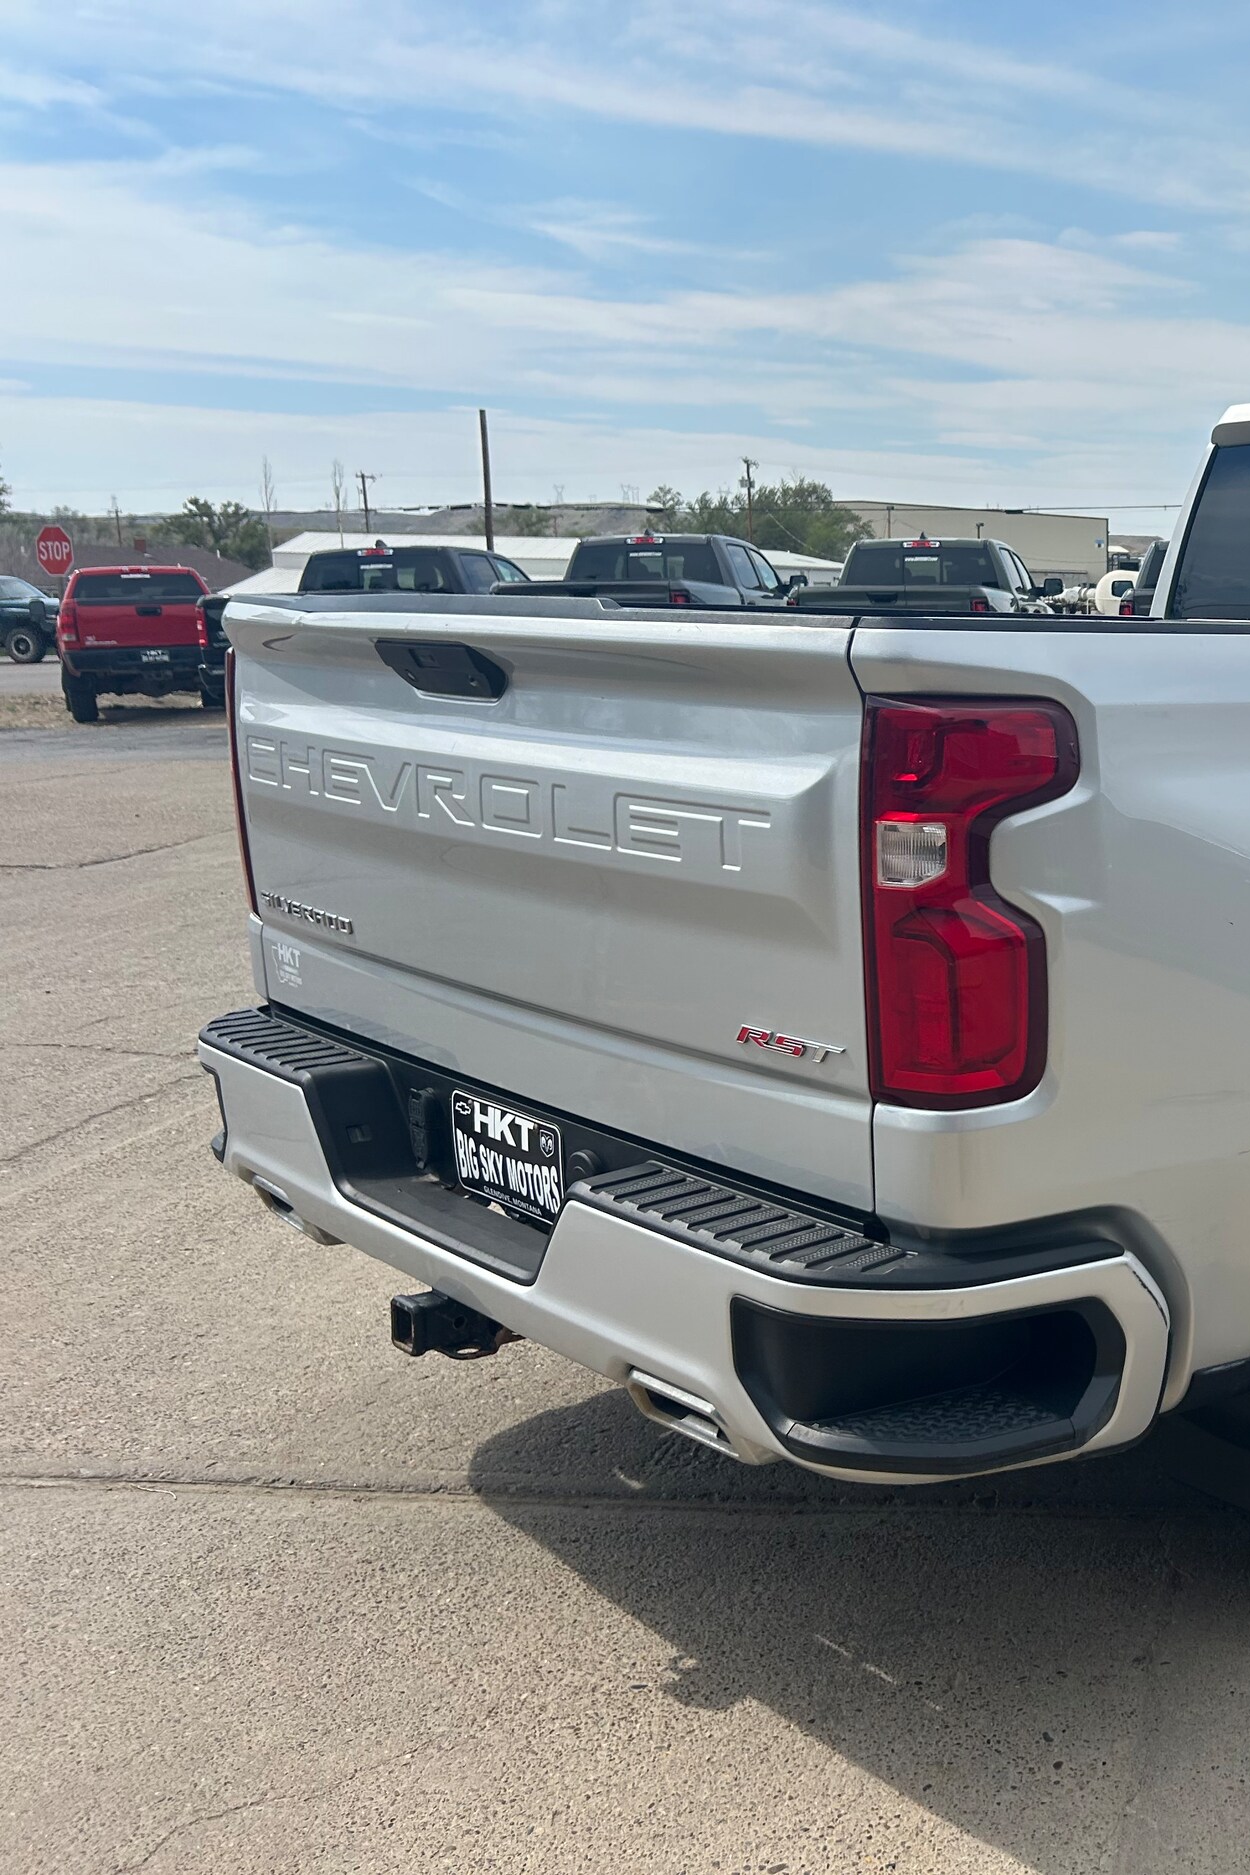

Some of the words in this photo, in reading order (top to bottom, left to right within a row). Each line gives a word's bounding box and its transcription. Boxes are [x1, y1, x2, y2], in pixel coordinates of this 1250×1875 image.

[39, 541, 70, 561] STOP
[246, 735, 771, 871] CHEVROLET
[261, 890, 354, 934] SILVERADO
[277, 943, 301, 968] HKT
[736, 1024, 847, 1063] RST
[473, 1102, 534, 1152] HKT
[456, 1128, 480, 1180] BIG
[479, 1143, 505, 1187] SKY
[505, 1157, 561, 1215] MOTORS
[512, 1198, 542, 1216] MONTANA
